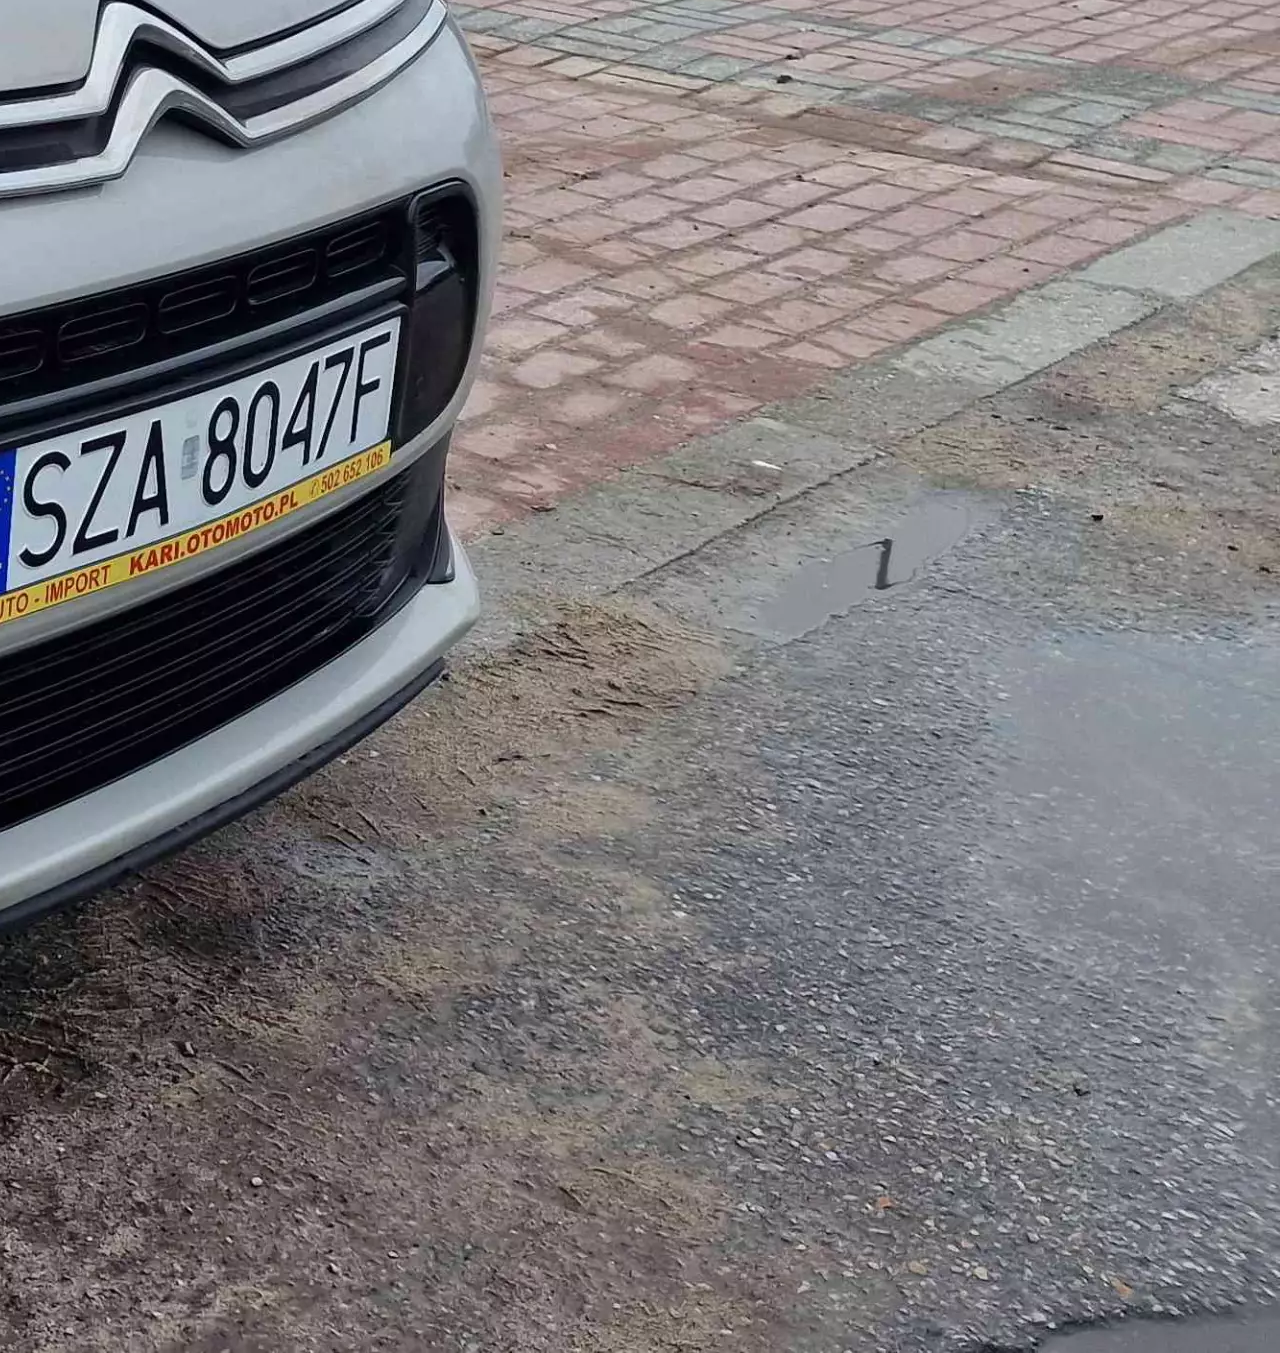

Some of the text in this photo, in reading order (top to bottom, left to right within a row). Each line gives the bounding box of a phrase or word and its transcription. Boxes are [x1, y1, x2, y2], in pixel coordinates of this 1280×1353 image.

[18, 330, 393, 568] SZA 8047F
[44, 564, 112, 603] IMPORT
[129, 490, 299, 576] KARI.OTOMOTO.PL
[320, 470, 340, 494] 502
[342, 460, 363, 482] 652
[365, 450, 384, 470] 106
